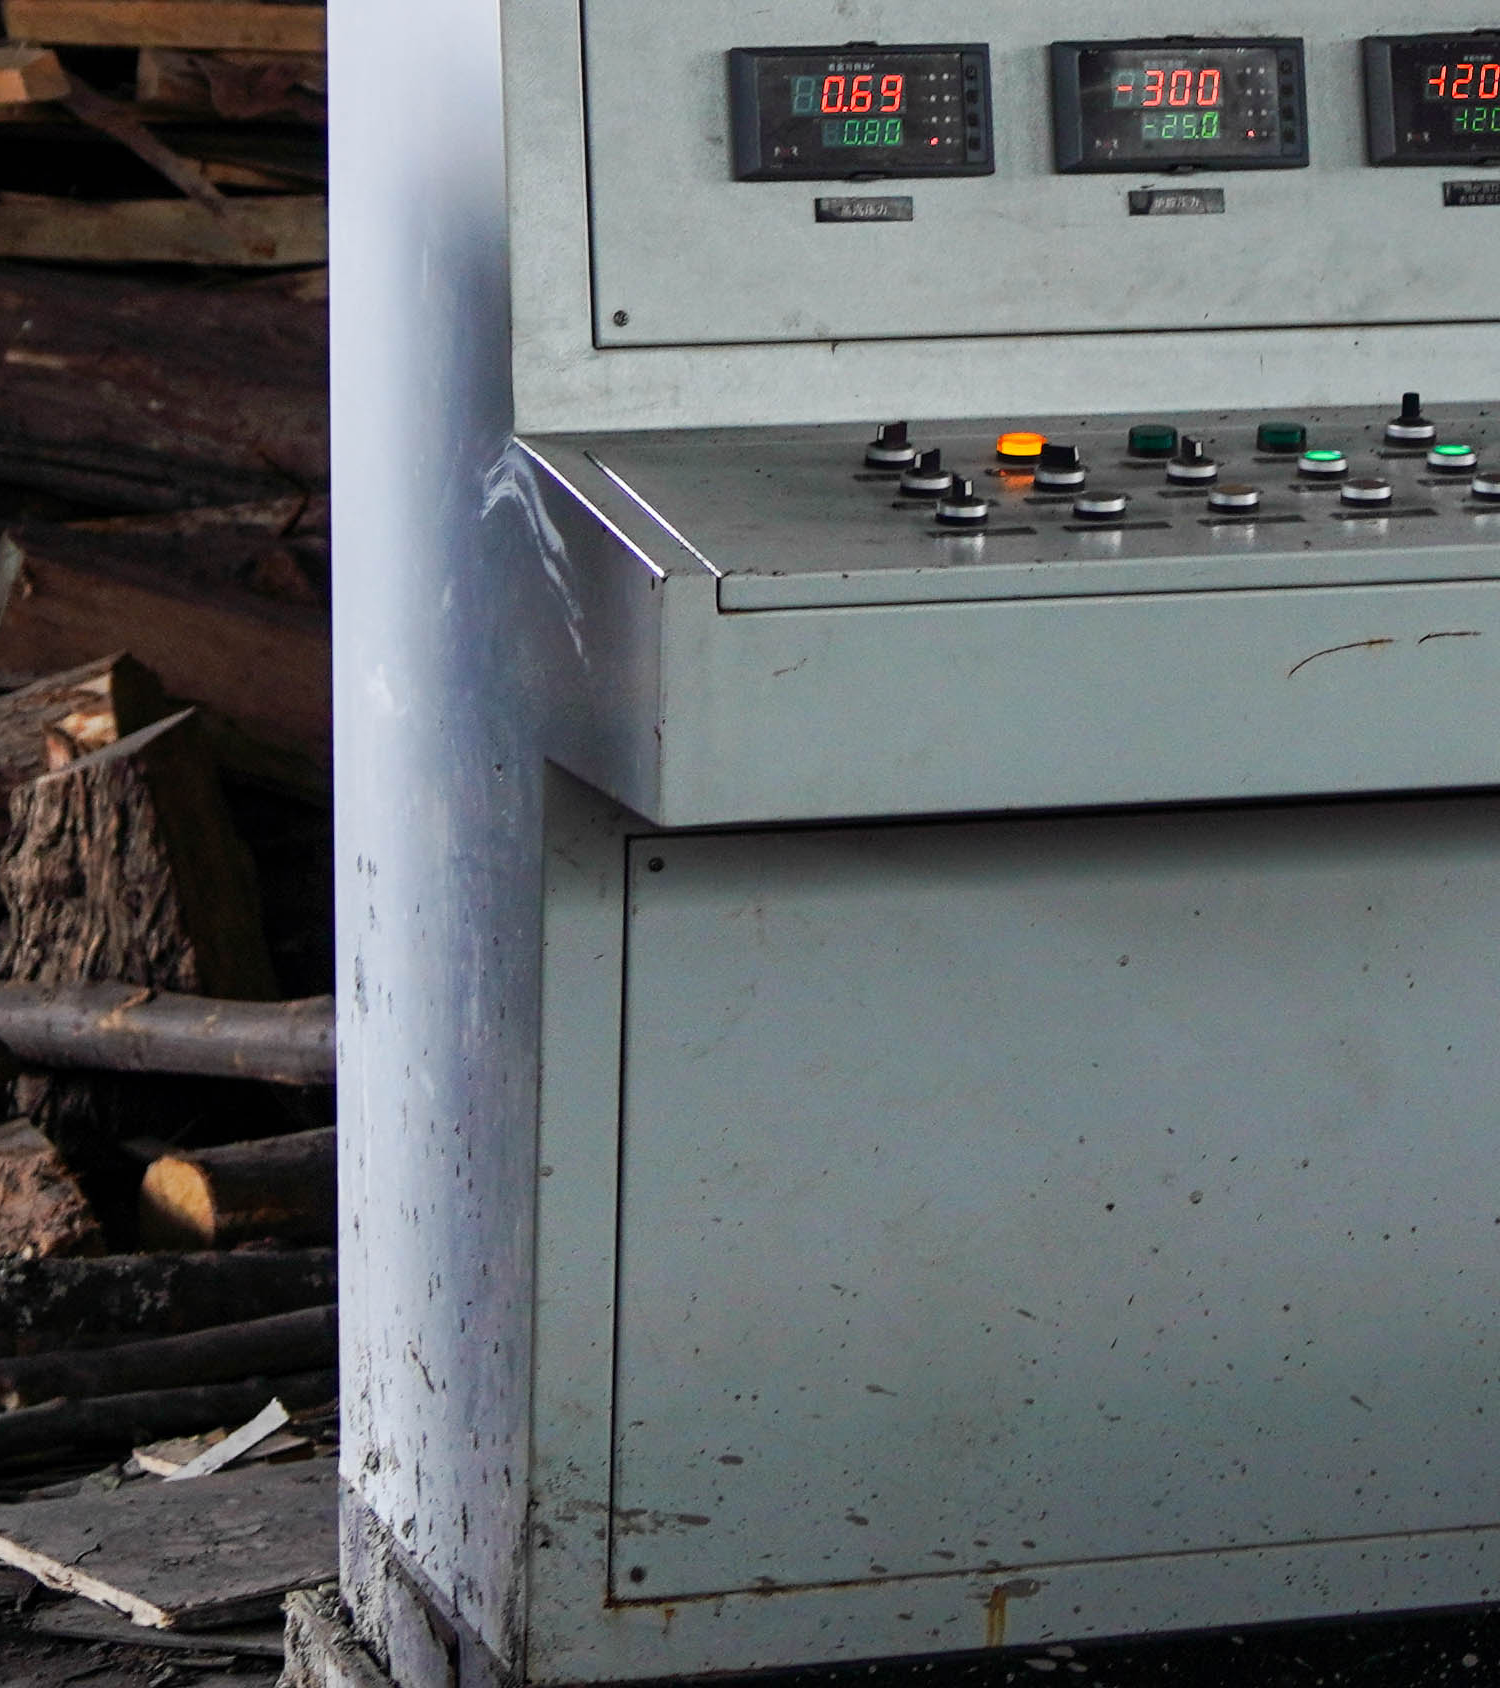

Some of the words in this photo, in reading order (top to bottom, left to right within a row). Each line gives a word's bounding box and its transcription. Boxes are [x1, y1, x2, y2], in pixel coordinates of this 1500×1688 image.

[820, 75, 903, 113] 0.69
[1115, 70, 1221, 107] -300
[1144, 112, 1219, 139] -25.0
